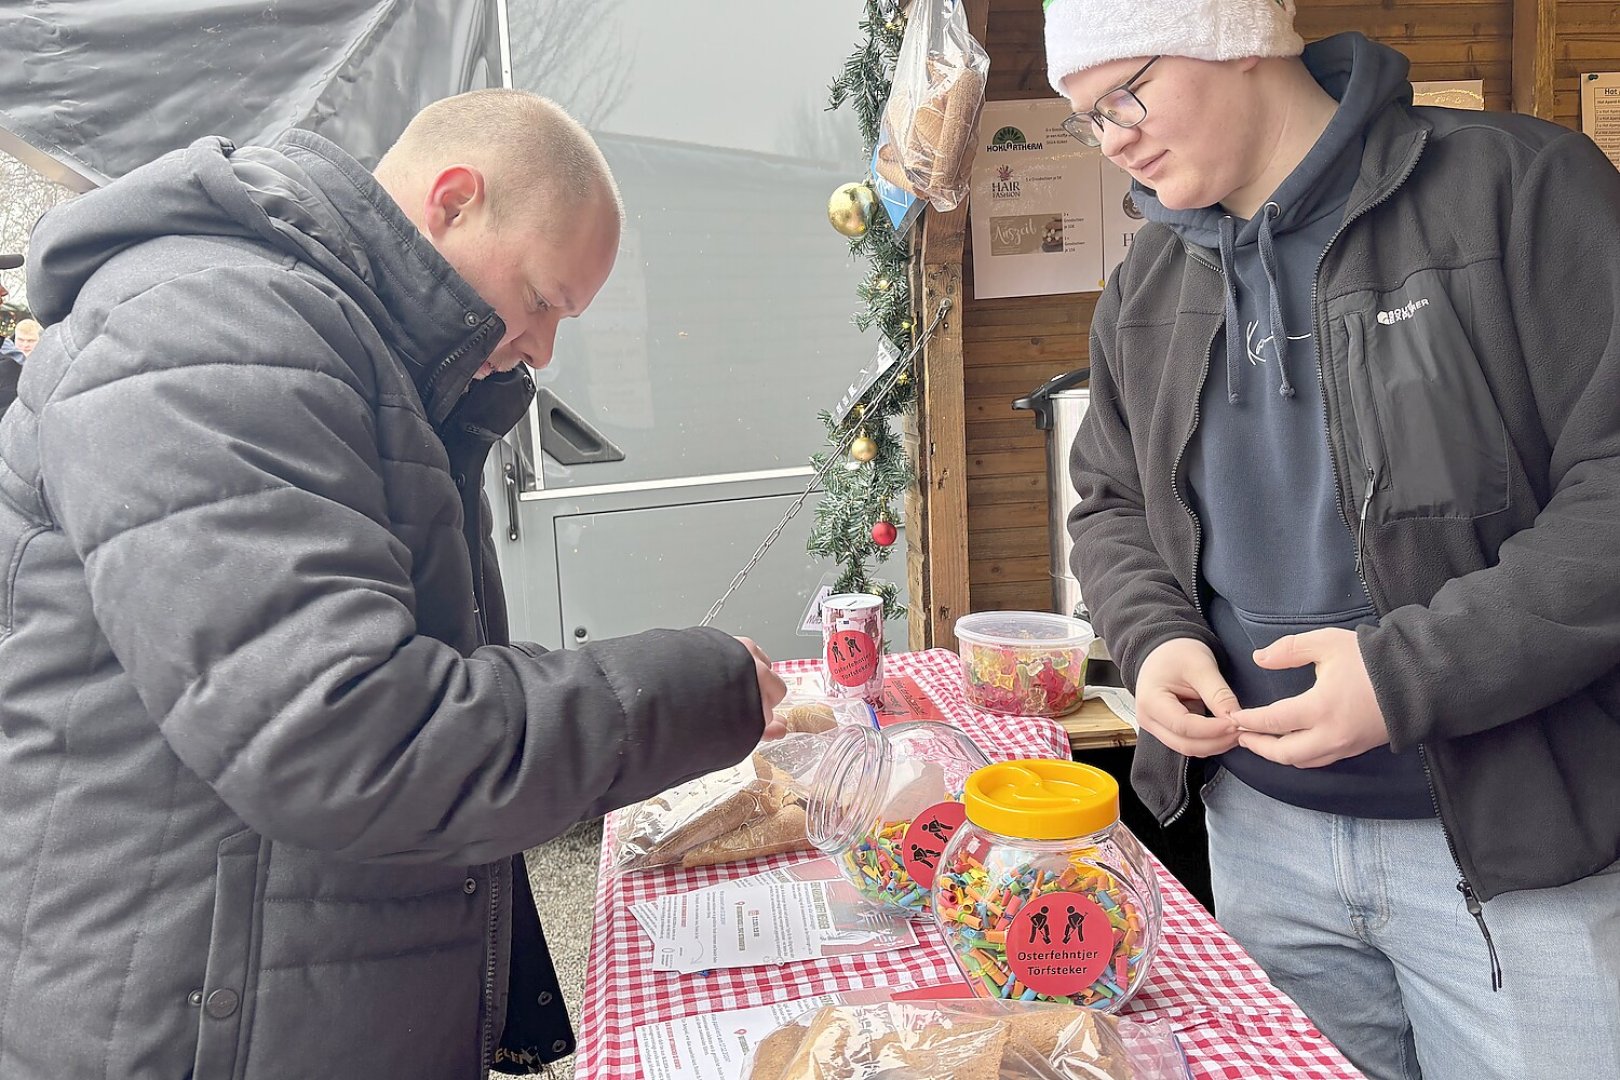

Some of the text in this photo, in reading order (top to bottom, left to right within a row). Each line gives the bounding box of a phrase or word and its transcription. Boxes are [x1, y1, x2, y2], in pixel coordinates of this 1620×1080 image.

[992, 181, 1021, 192] HAIR
[992, 191, 1021, 199] FASHION
[1017, 949, 1098, 961] Osterfehntjer
[1027, 965, 1087, 976] Törfsteker
